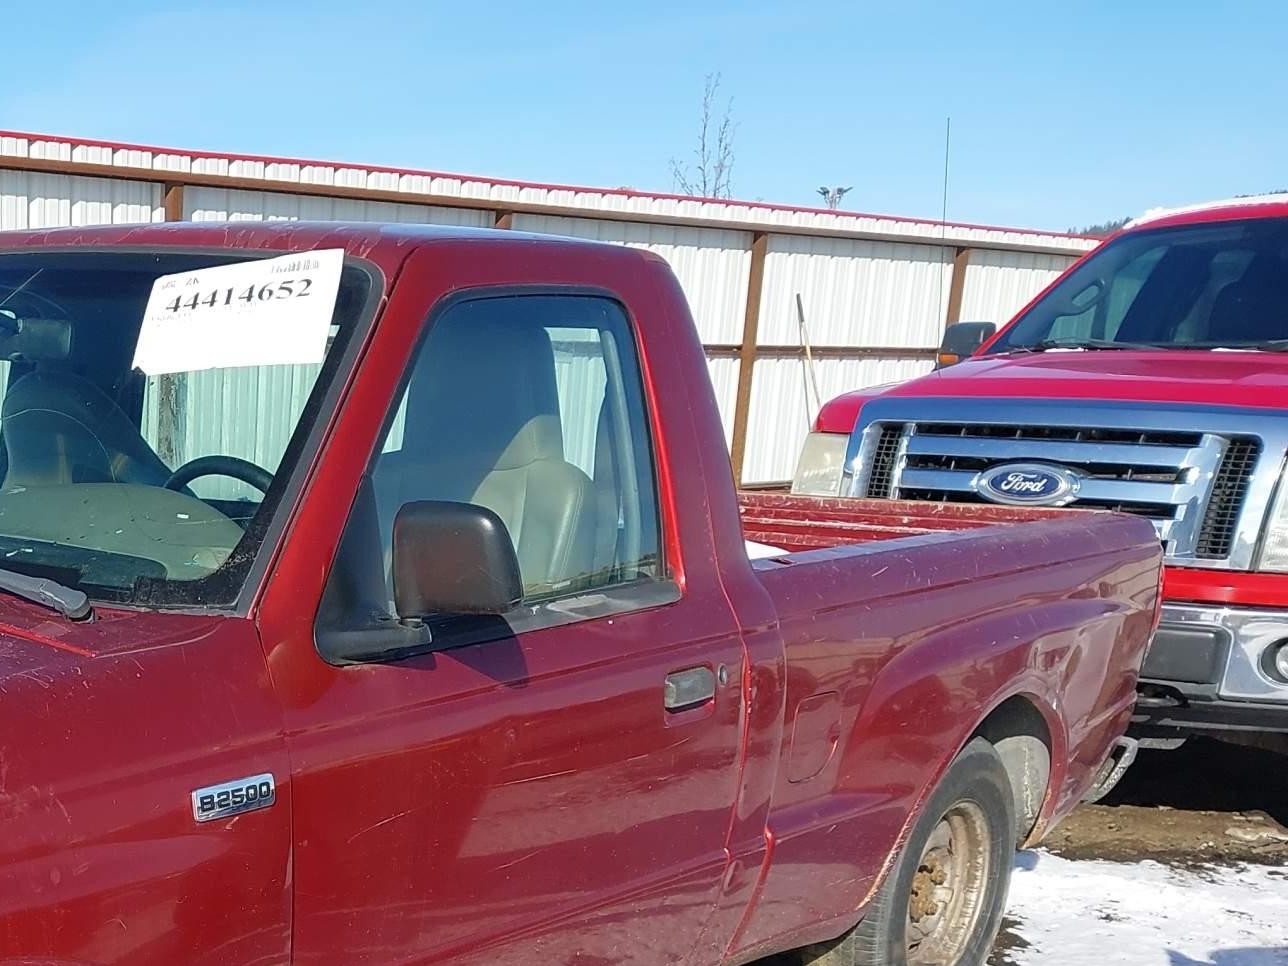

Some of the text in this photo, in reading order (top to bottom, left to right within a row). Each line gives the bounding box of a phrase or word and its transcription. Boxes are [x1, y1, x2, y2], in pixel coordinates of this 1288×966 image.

[165, 278, 312, 312] 44414652
[1000, 472, 1048, 492] Ford
[199, 781, 271, 812] B2500
